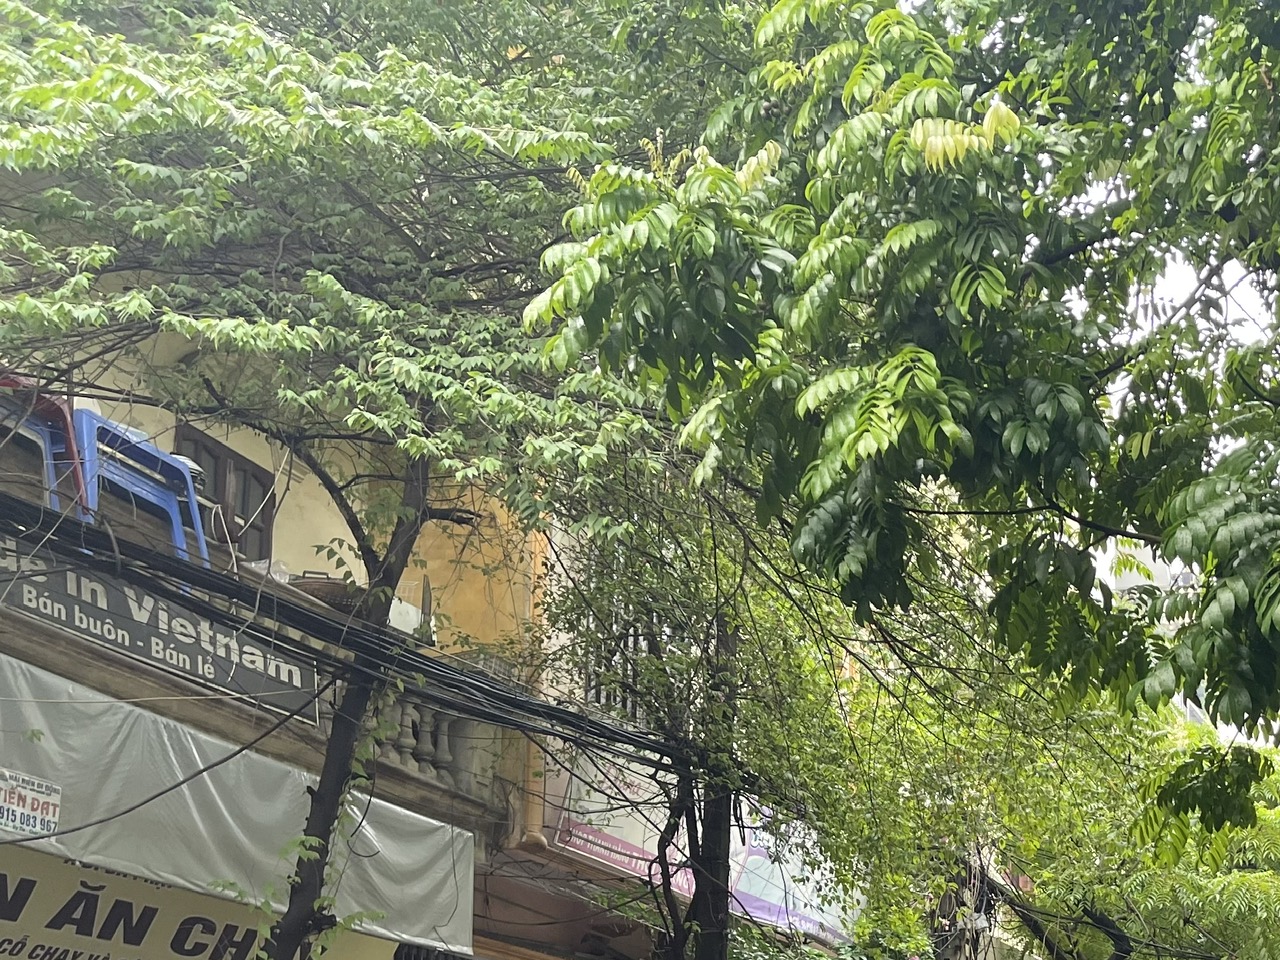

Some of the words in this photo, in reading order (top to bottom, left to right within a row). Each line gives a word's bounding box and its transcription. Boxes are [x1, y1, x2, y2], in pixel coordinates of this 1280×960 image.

[22, 584, 67, 621] Bán
[74, 605, 130, 647] buôn
[151, 638, 192, 672] Bán
[198, 654, 216, 680] lẻ
[123, 585, 302, 689] Vietnam
[20, 811, 37, 829] 083
[40, 818, 58, 833] 967
[44, 880, 159, 947] ĂN
